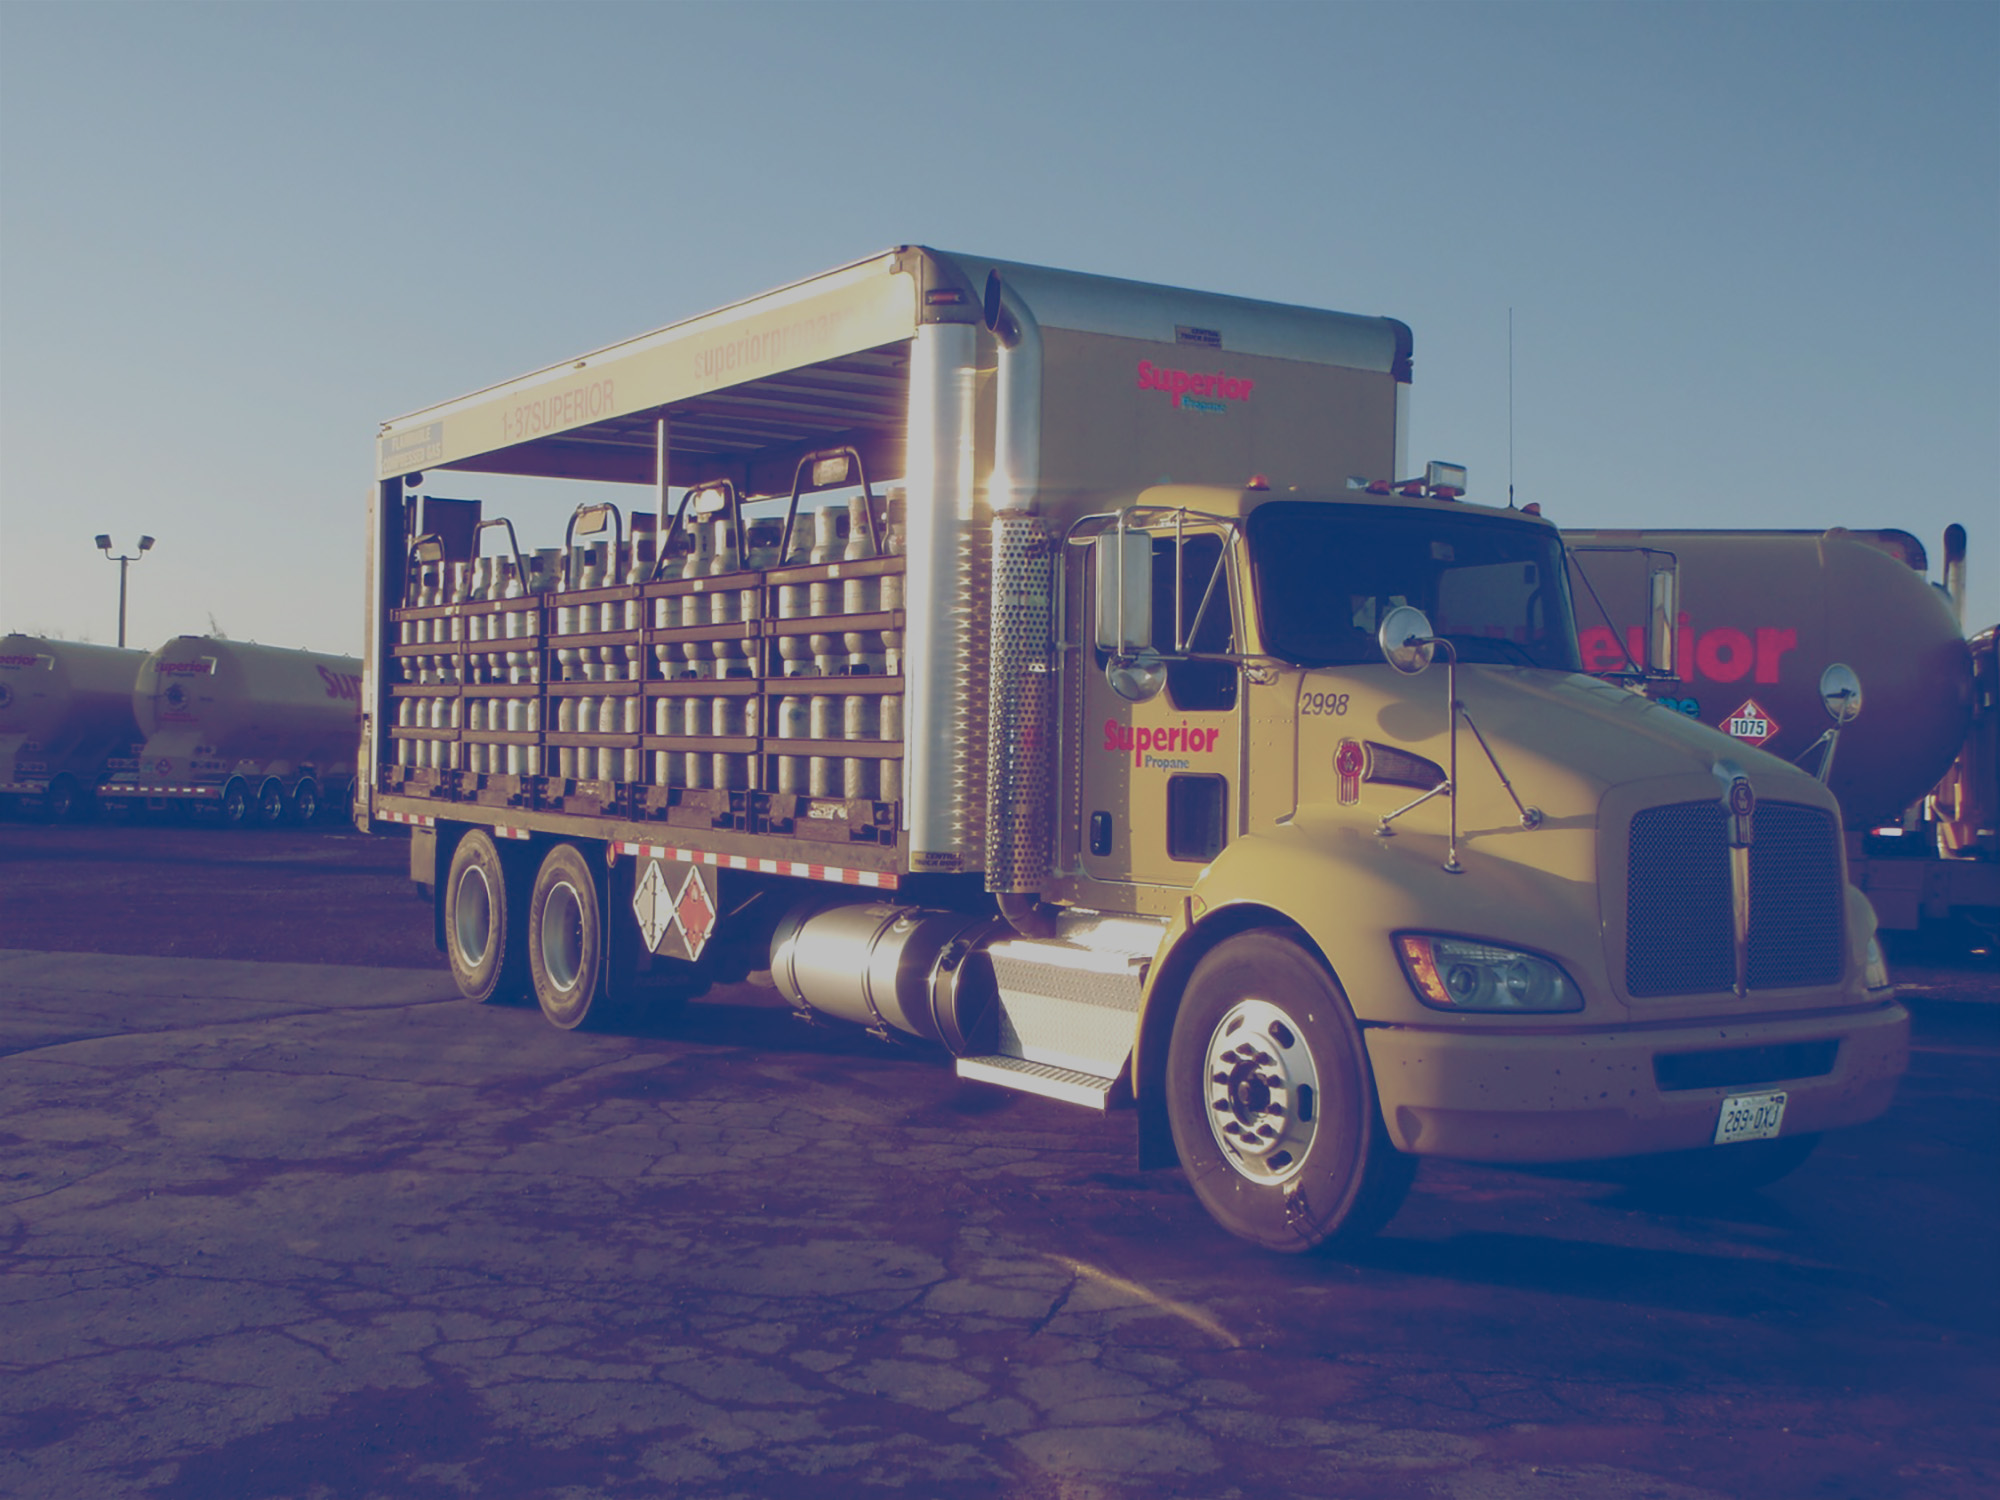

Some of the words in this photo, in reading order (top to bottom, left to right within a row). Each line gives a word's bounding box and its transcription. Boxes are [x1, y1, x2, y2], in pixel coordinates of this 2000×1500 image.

[1137, 360, 1254, 408] Superior
[391, 426, 431, 452] FLALE
[1301, 692, 1350, 716] 2998
[1733, 720, 1765, 736] 1075
[1103, 719, 1220, 768] Superior
[1144, 754, 1190, 773] Propane
